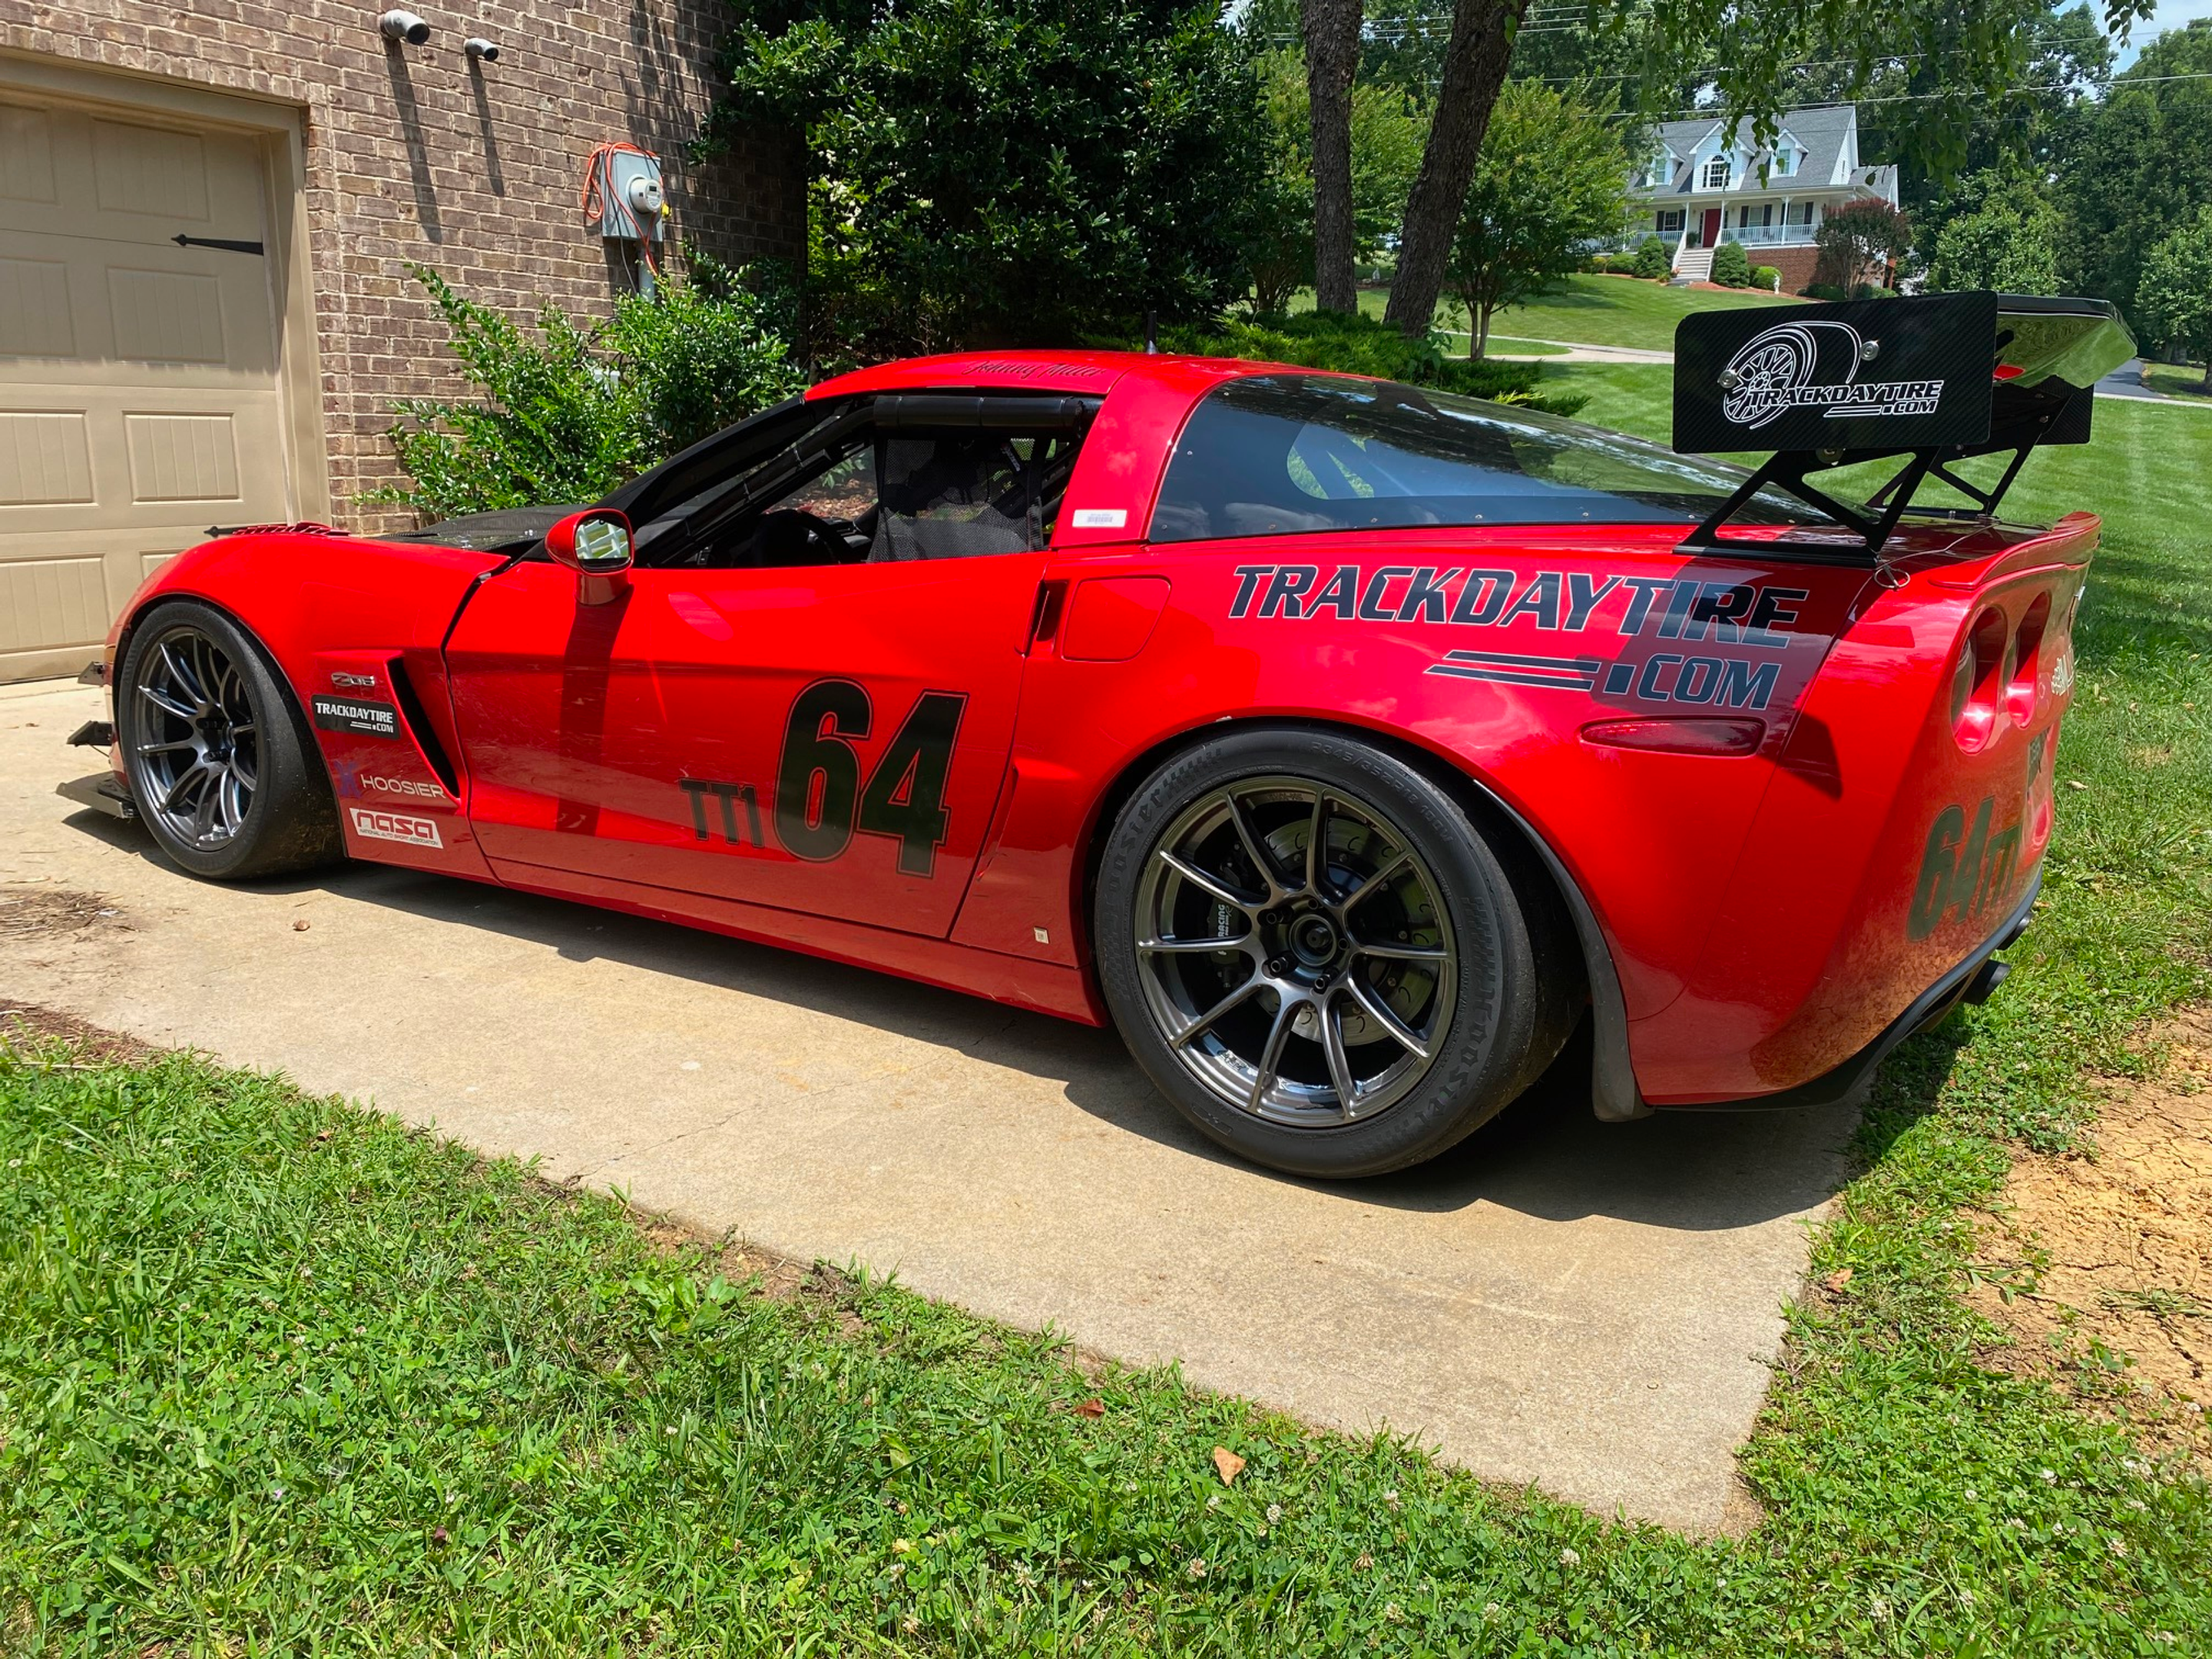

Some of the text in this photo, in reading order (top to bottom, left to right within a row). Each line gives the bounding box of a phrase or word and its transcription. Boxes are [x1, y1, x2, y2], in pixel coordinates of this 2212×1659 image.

[1748, 380, 1944, 407] TRACKDAYTIRE
[1882, 399, 1939, 416] .COM
[1228, 565, 1807, 648] TRACKDAYTIRE
[1602, 654, 1780, 711] .COM
[315, 701, 393, 724] TRACKDAYTIRE
[373, 723, 394, 733] .COM
[360, 773, 446, 799] HOOSIER
[679, 676, 970, 879] TT1 64
[1906, 795, 1995, 942] 64
[1217, 903, 1226, 937] RACING
